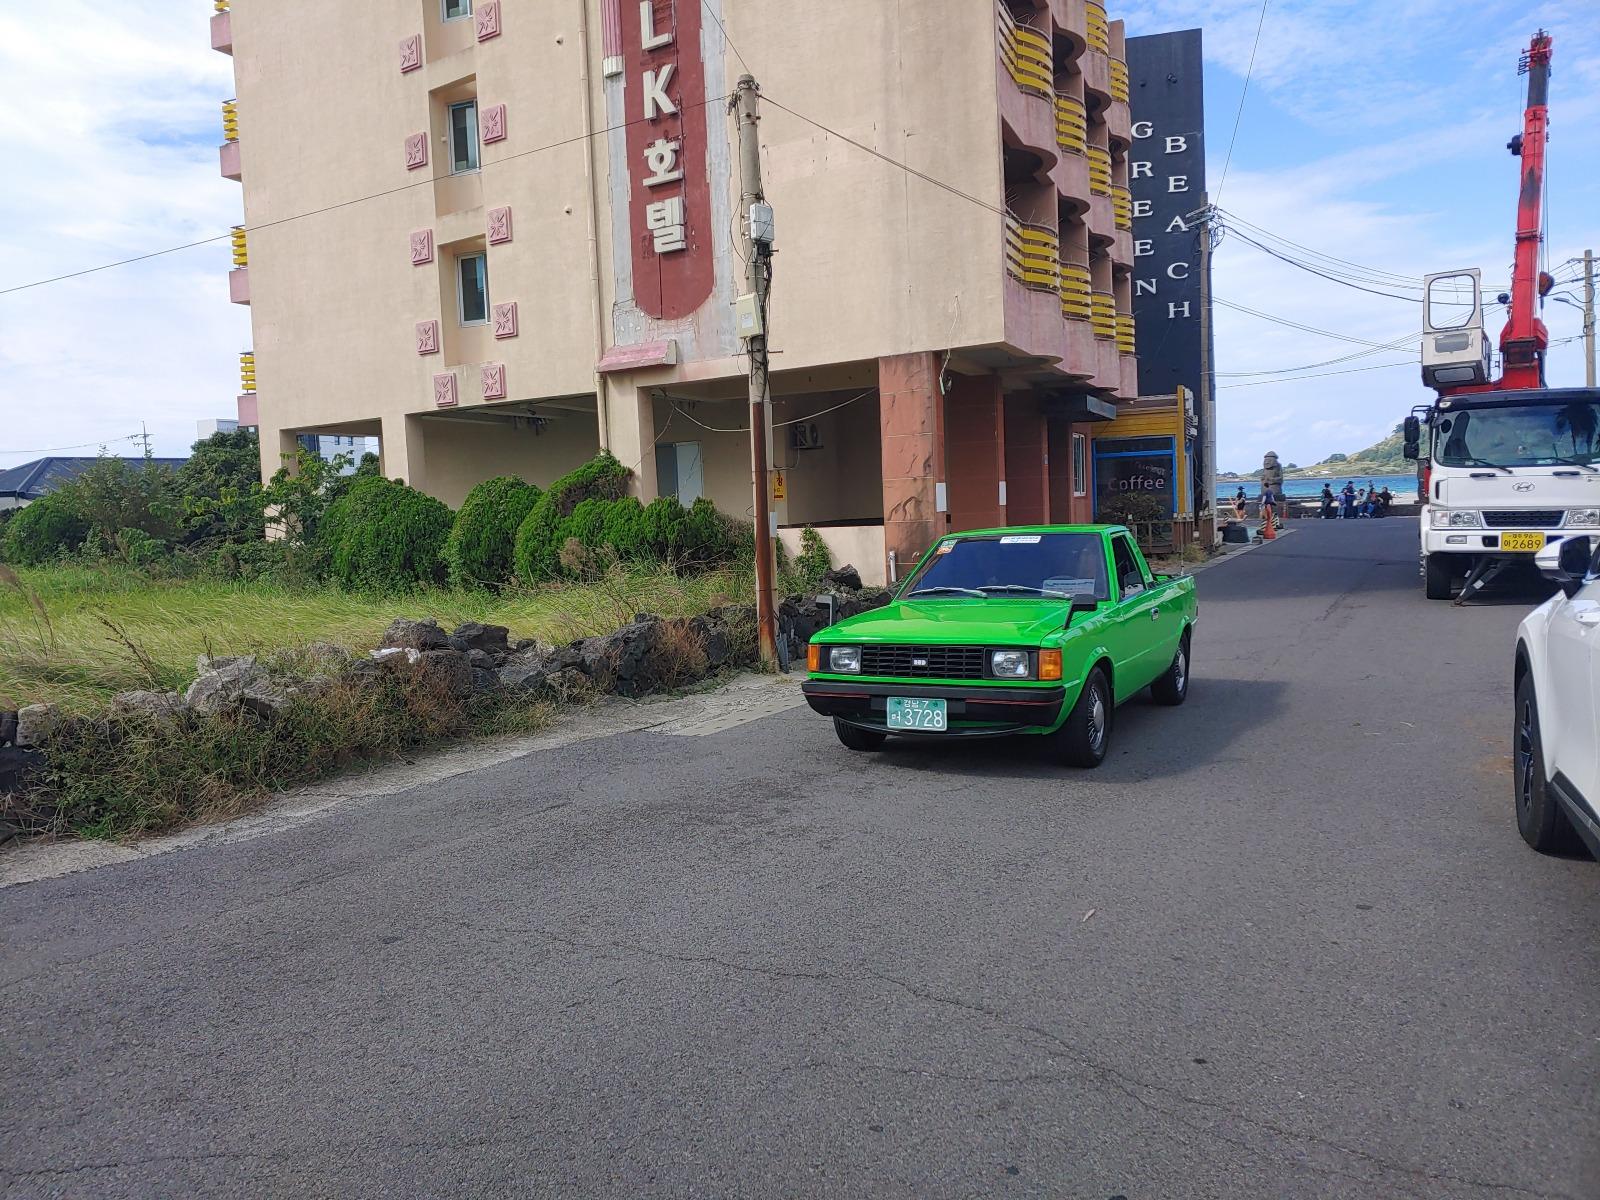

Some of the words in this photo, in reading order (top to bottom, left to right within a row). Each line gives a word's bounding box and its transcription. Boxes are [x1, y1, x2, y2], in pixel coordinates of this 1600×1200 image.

[1130, 121, 1158, 296] GREEN
[1164, 136, 1191, 319] BEACH
[1108, 475, 1165, 491] Coffee
[1512, 539, 1541, 549] 2689
[921, 700, 929, 709] 7
[904, 708, 943, 727] 3728
